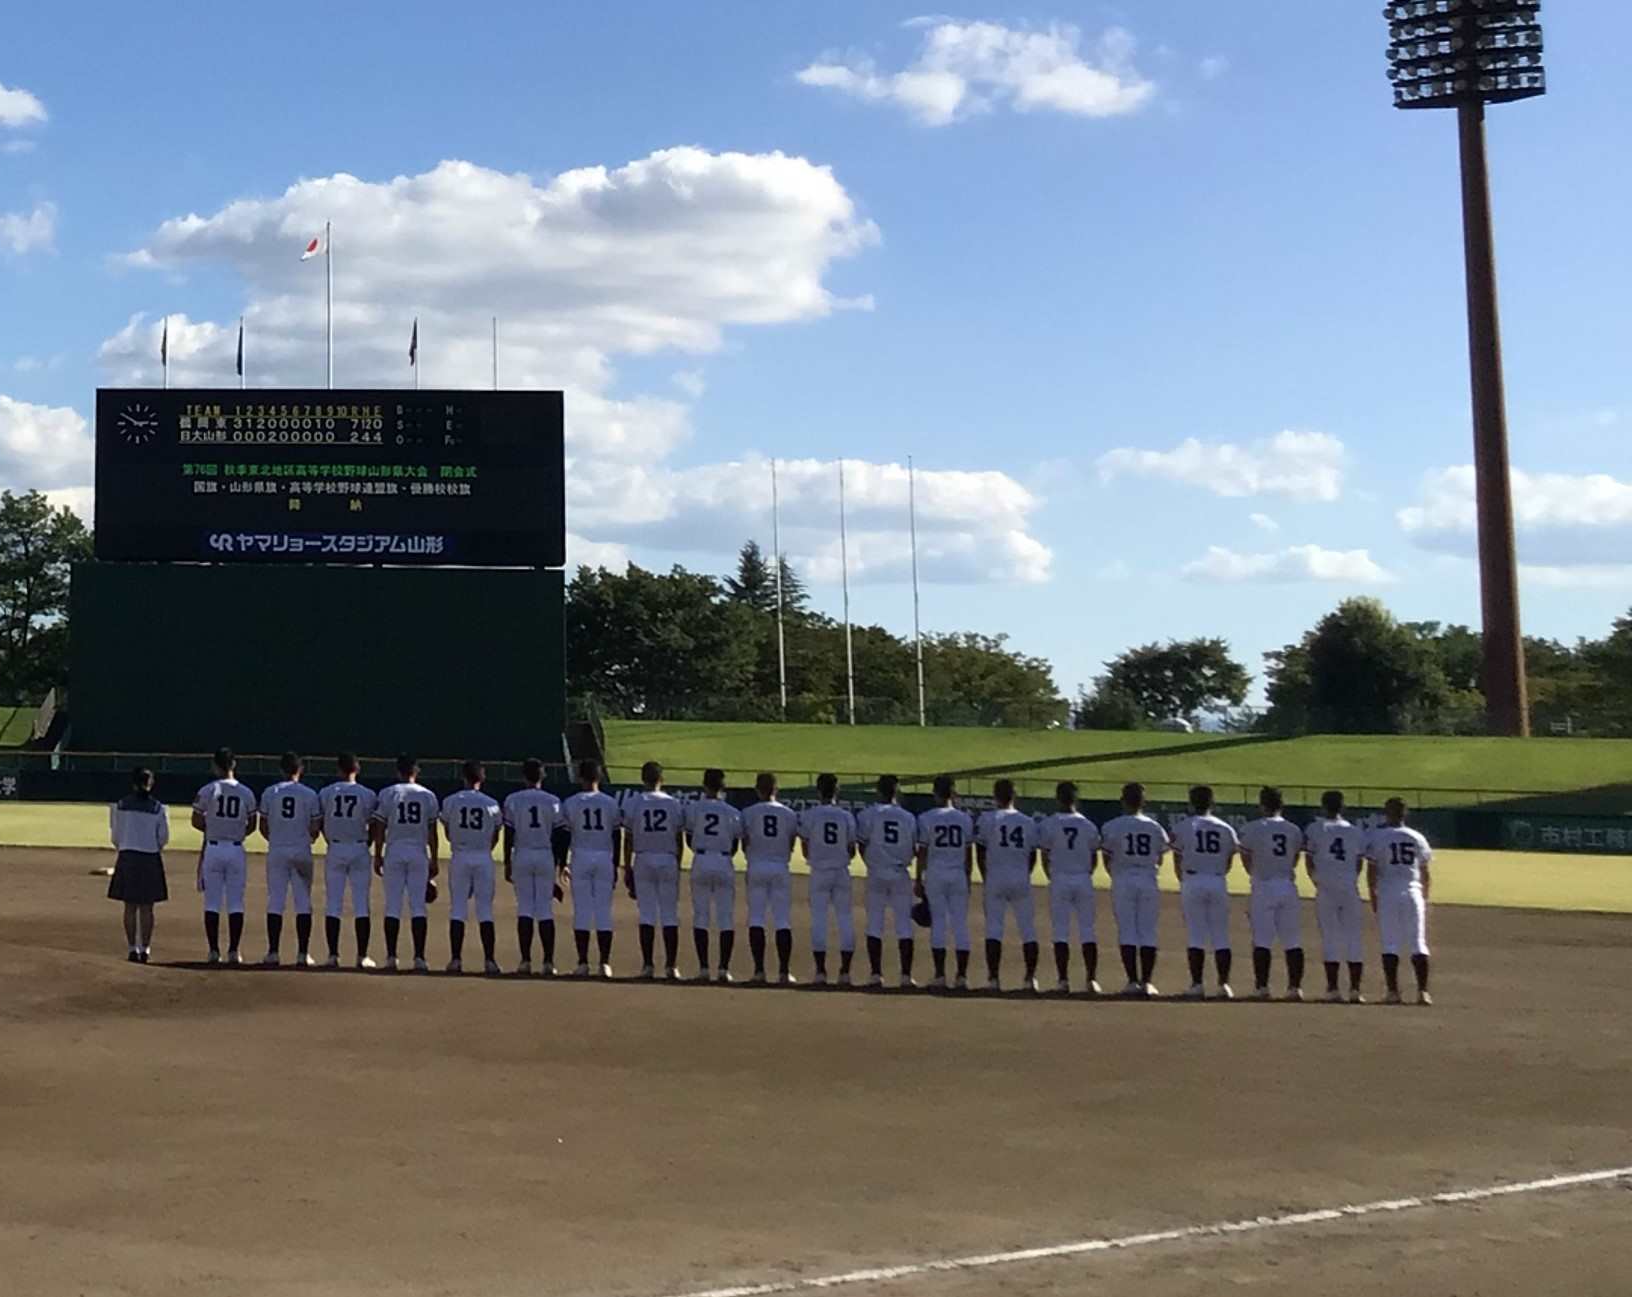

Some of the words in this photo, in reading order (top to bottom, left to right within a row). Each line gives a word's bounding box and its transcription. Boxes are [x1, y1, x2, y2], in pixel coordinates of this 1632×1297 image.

[216, 795, 240, 818] 10
[282, 797, 295, 819] 9
[334, 795, 358, 818] 17
[398, 802, 421, 824] 19
[529, 806, 540, 828] 1
[459, 807, 483, 830] 13
[583, 808, 604, 831] 11
[643, 809, 667, 832] 12
[705, 813, 719, 836] 2
[764, 815, 777, 837] 8
[824, 822, 838, 845] 6
[884, 821, 898, 844] 5
[935, 825, 962, 847] 20
[1000, 825, 1024, 847] 14
[1063, 827, 1078, 849] 7
[1195, 830, 1219, 853] 16
[1125, 833, 1151, 856] 18
[1272, 833, 1287, 856] 3
[1330, 838, 1345, 860] 4
[1389, 842, 1415, 865] 15
